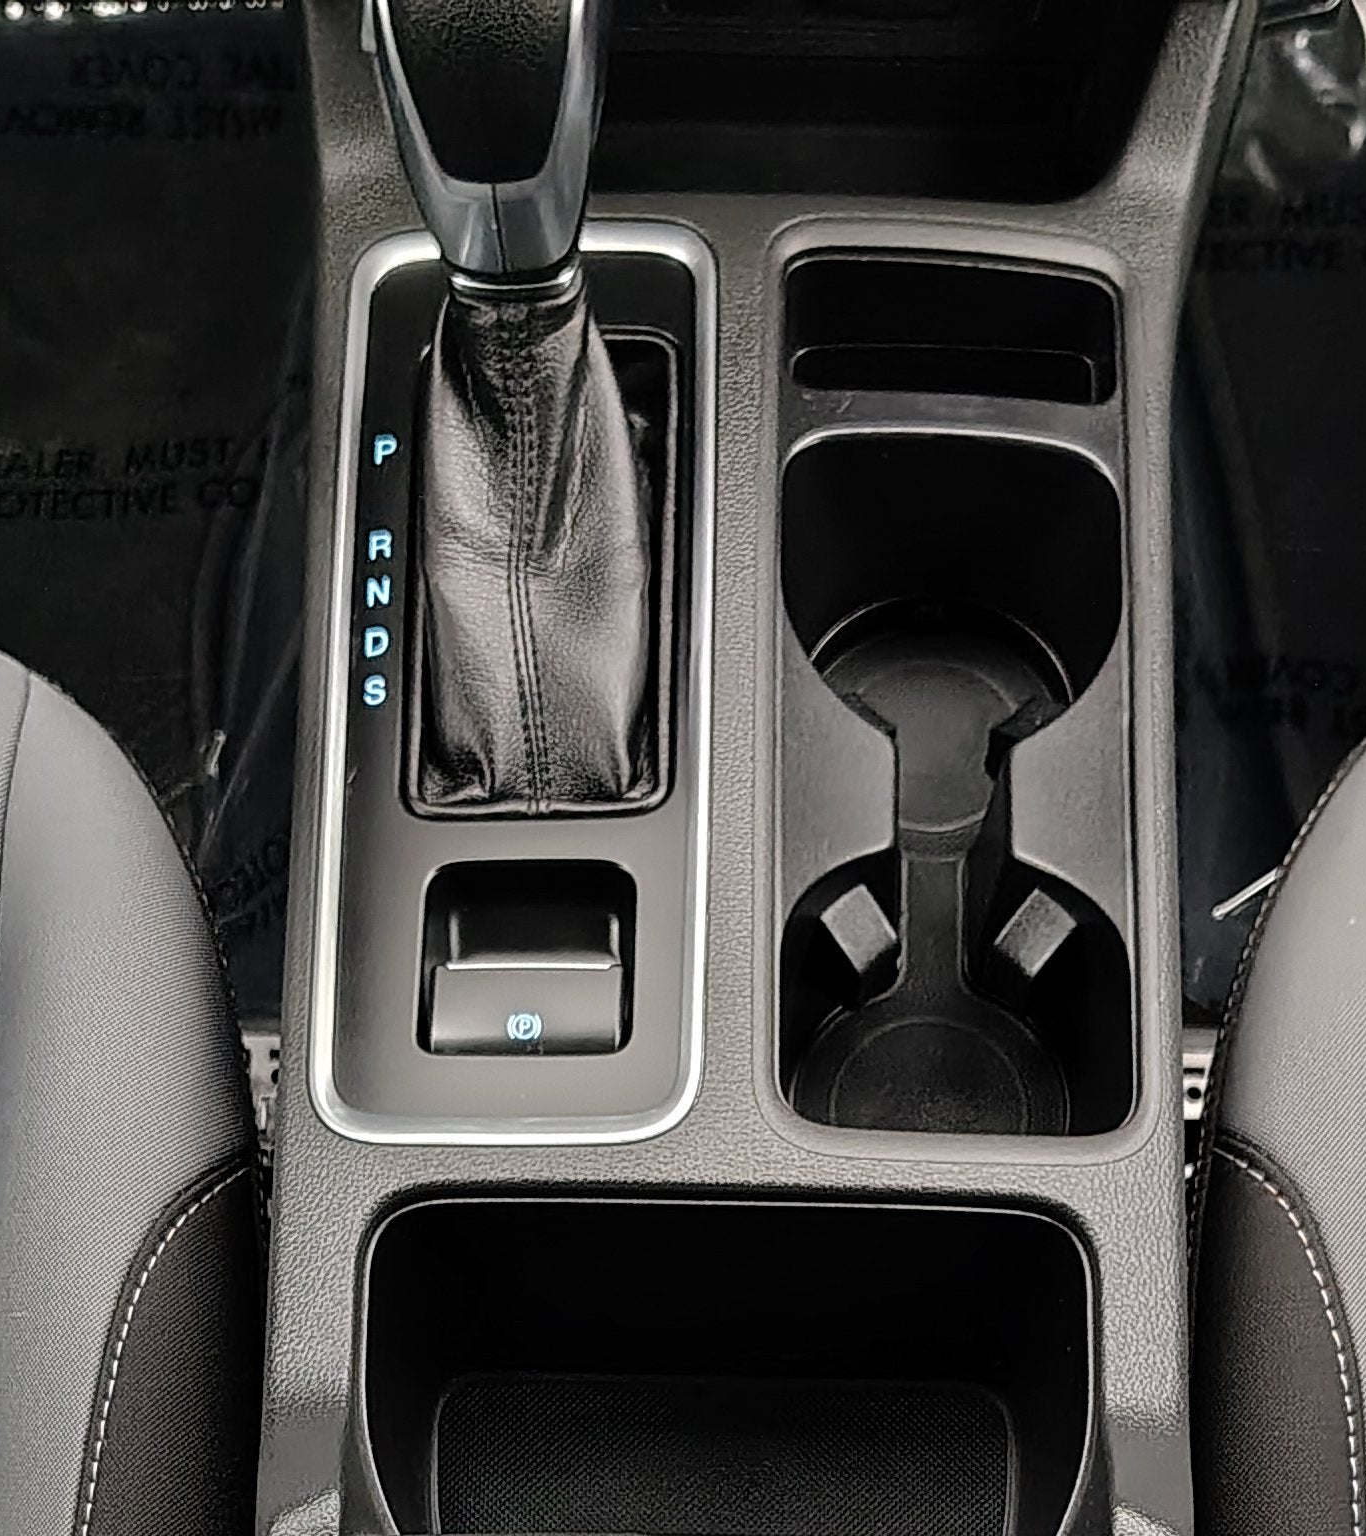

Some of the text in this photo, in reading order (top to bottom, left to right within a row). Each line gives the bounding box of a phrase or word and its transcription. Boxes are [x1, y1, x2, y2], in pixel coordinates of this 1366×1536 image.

[125, 436, 233, 474] MUST
[374, 434, 398, 466] P
[368, 529, 393, 561] R
[366, 575, 391, 607] N
[364, 628, 389, 659] D
[362, 675, 387, 706] S
